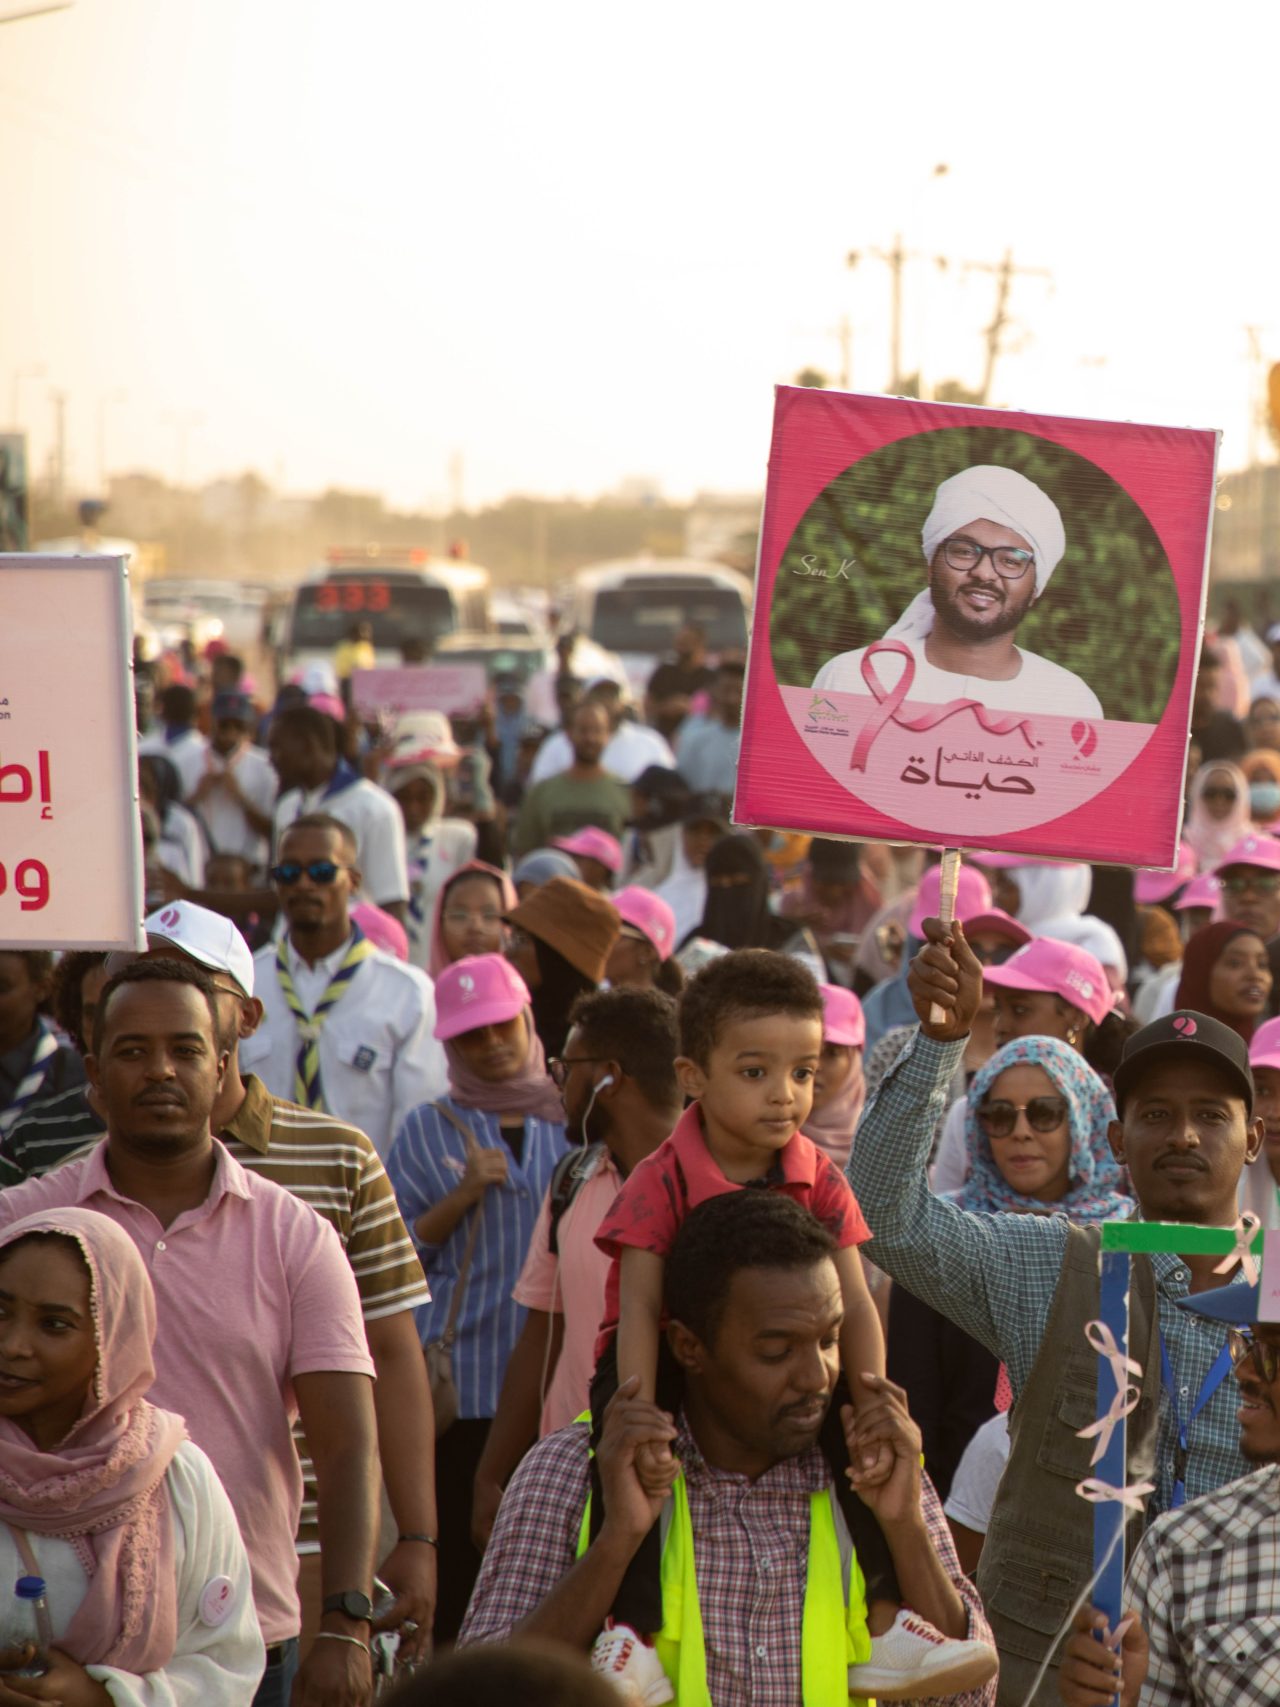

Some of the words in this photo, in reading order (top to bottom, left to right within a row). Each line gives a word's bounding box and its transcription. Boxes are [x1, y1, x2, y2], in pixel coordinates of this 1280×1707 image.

[943, 750, 985, 763] الذاتي
[987, 754, 1039, 768] الكشف
[900, 746, 1036, 800] حياة
